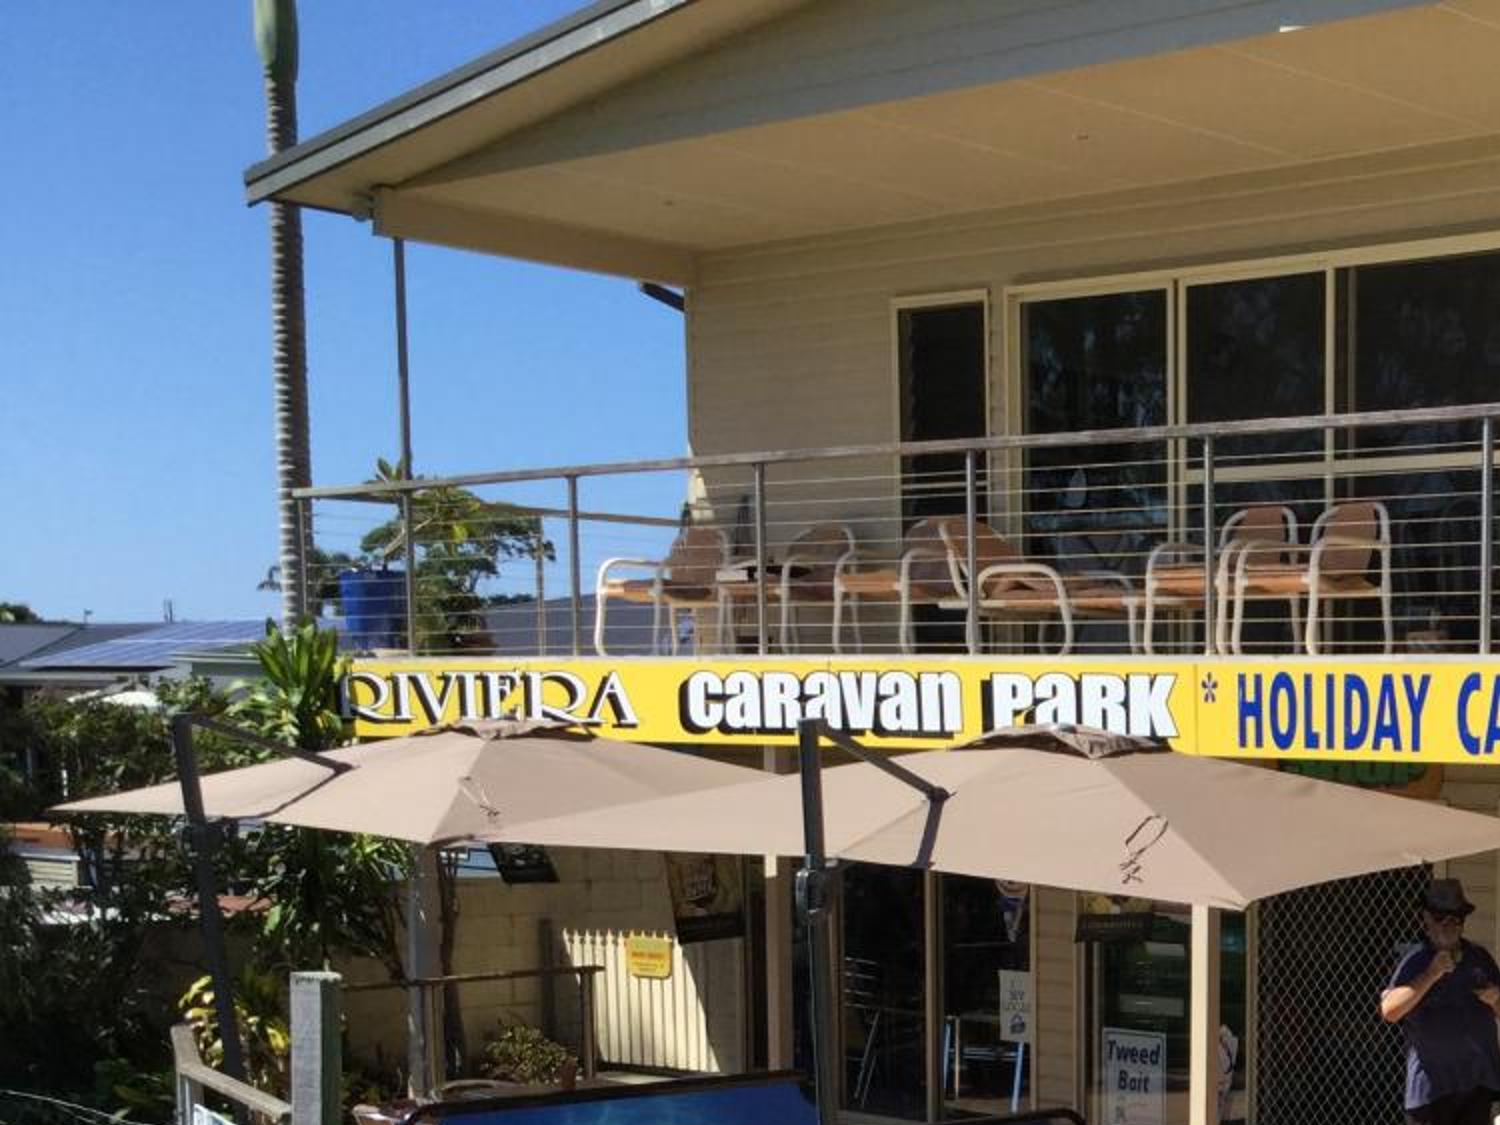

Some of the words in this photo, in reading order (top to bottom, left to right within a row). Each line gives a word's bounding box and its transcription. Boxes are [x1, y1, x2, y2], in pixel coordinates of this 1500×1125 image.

[342, 668, 639, 728] RIVIERA
[1237, 671, 1432, 752] HOLIDAY
[1107, 1040, 1160, 1065] Tweed
[1118, 1069, 1150, 1093] Bait
